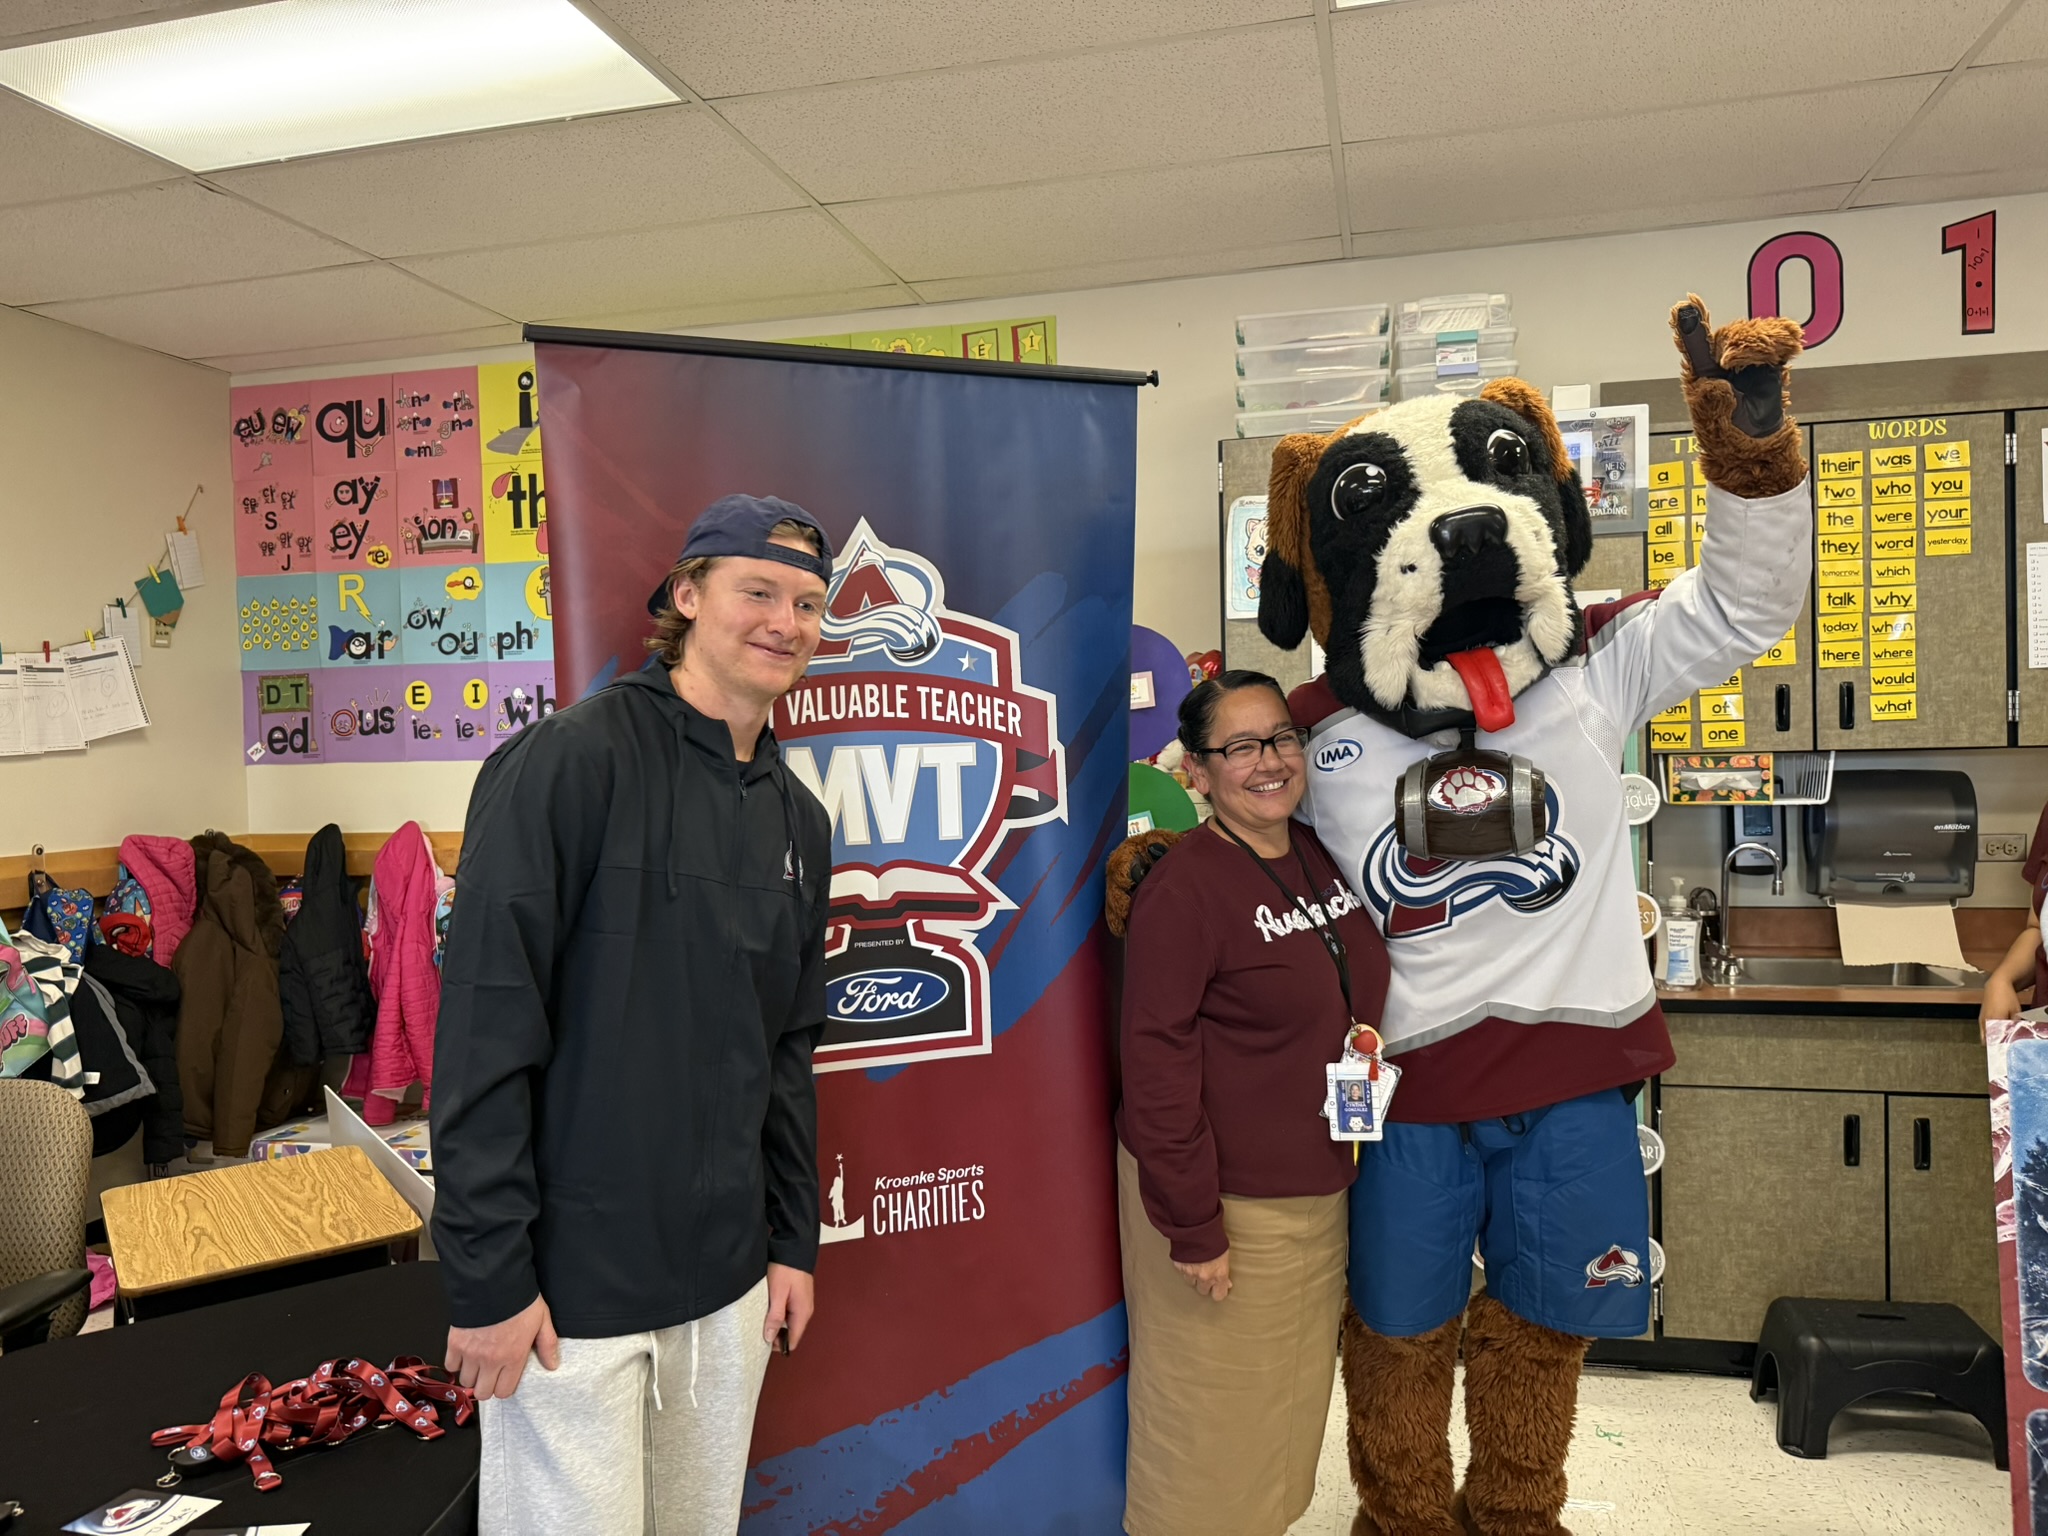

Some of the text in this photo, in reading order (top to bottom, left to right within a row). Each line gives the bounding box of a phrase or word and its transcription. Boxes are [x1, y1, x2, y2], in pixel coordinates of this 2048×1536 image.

[1941, 209, 1996, 335] 1
[1747, 231, 1844, 350] 0
[316, 398, 385, 458] qu
[1868, 418, 1947, 440] WORDS
[1875, 454, 1912, 466] was
[1934, 449, 1961, 461] we
[1605, 462, 1625, 471] NETS
[1821, 458, 1861, 473] their
[1657, 470, 1669, 482] a
[1824, 485, 1856, 499] two
[1875, 481, 1912, 495] who
[1931, 480, 1963, 495] you
[334, 476, 380, 515] ay
[1649, 497, 1679, 509] are
[265, 511, 277, 530] S
[1826, 512, 1854, 526] the
[1875, 511, 1912, 523] were
[1927, 507, 1968, 523] your
[1655, 521, 1672, 535] all
[332, 520, 369, 559] ey
[1875, 536, 1914, 550] word
[1927, 537, 1968, 547] yesterday
[1821, 540, 1860, 555] they
[281, 555, 291, 571] J
[1653, 550, 1675, 563] be
[1876, 565, 1910, 577] which
[1826, 592, 1857, 606] talk
[1874, 591, 1912, 607] why
[407, 607, 446, 630] ow
[1823, 621, 1858, 633] today
[1872, 621, 1913, 634] when
[438, 632, 479, 656] ou
[498, 621, 533, 660] ph
[1822, 649, 1860, 661] there
[1873, 648, 1913, 659] where
[1872, 672, 1914, 685] would
[266, 684, 303, 704] D T
[412, 685, 426, 705] E
[472, 684, 480, 703] I
[785, 683, 909, 726] VALUABLE
[916, 685, 1022, 737] TEACHER
[1712, 701, 1730, 713] of
[1875, 699, 1912, 712] what
[267, 717, 309, 755] ed
[1652, 728, 1687, 742] how
[1708, 729, 1738, 741] one
[1321, 746, 1353, 765] IMA
[786, 742, 976, 845] MVT
[1933, 823, 1970, 831] enMotion
[854, 940, 894, 948] PRESENTED
[837, 976, 923, 1014] Ford
[875, 1164, 984, 1190] Kroenke Sports
[873, 1180, 985, 1235] CHARITIES
